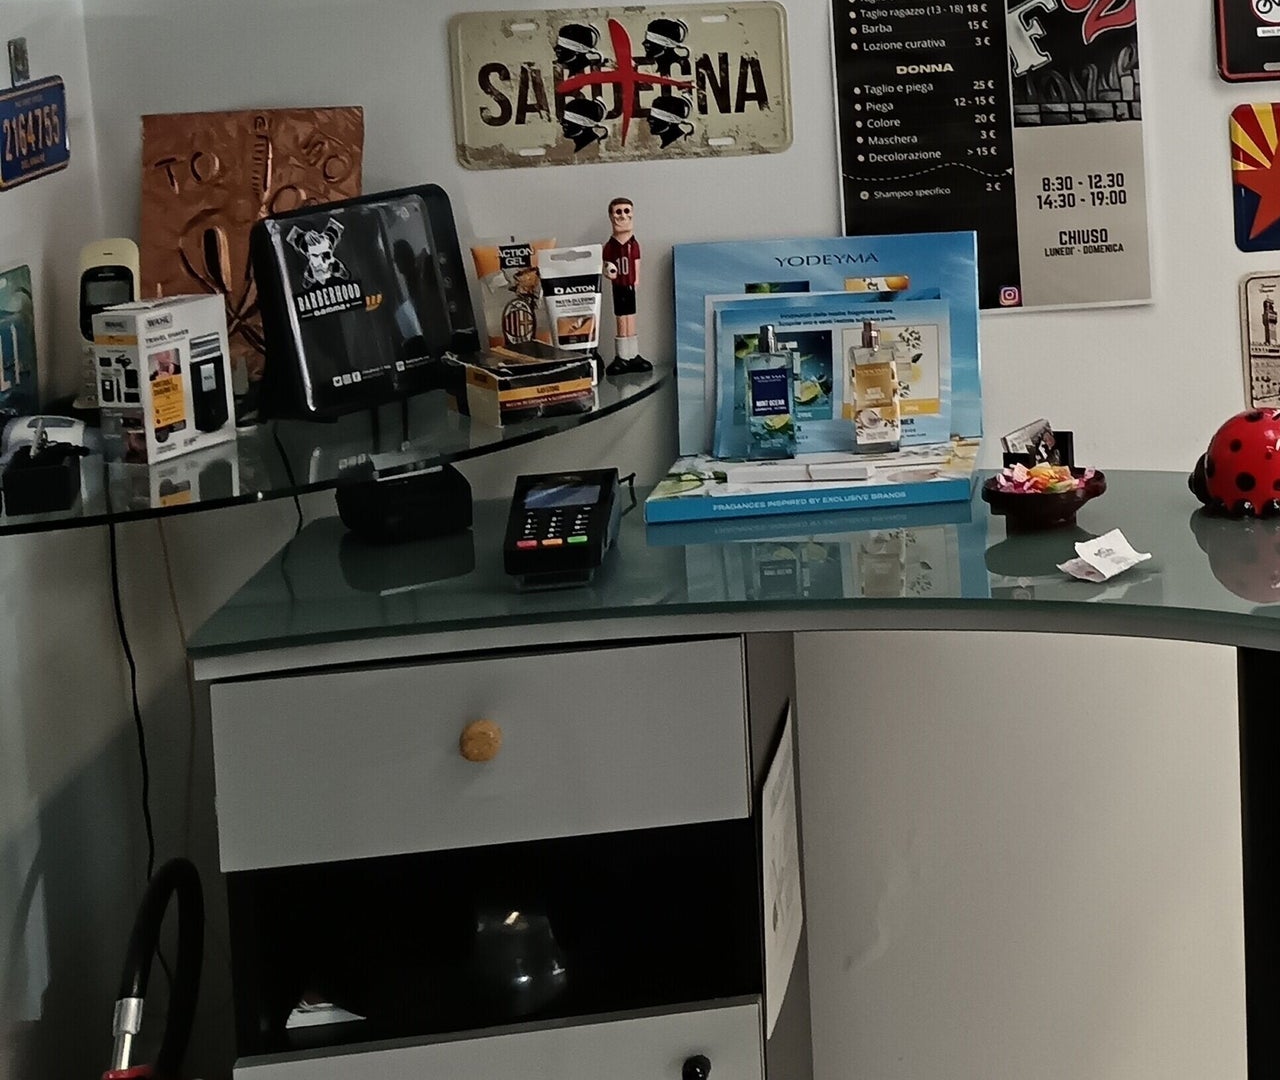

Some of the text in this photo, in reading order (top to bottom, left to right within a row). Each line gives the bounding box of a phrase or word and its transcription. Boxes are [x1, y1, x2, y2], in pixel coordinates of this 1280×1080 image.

[860, 8, 925, 19] Taglio ragazzo
[862, 24, 893, 33] Barba
[863, 38, 946, 51] Lozione curativa
[896, 63, 954, 74] DONNA
[864, 83, 934, 95] Taglio piega
[866, 102, 894, 113] Piega
[867, 119, 900, 128] Colore
[868, 135, 918, 146] Maschera
[869, 150, 941, 162] Decolorazione
[1042, 172, 1124, 192] 8:30 12.30
[874, 187, 950, 199] Shampoo specifico
[1037, 189, 1127, 210] 14:30 19:00
[1059, 228, 1108, 247] CHIUSO
[1083, 243, 1124, 255] DOMENICA
[505, 257, 526, 266] GEL
[616, 257, 628, 275] 10
[775, 252, 879, 268] YODEYMA
[565, 285, 596, 293] AXTON
[297, 284, 361, 312] BARBERHOOD
[768, 499, 807, 508] INSPIRED
[871, 491, 906, 499] BRANDS
